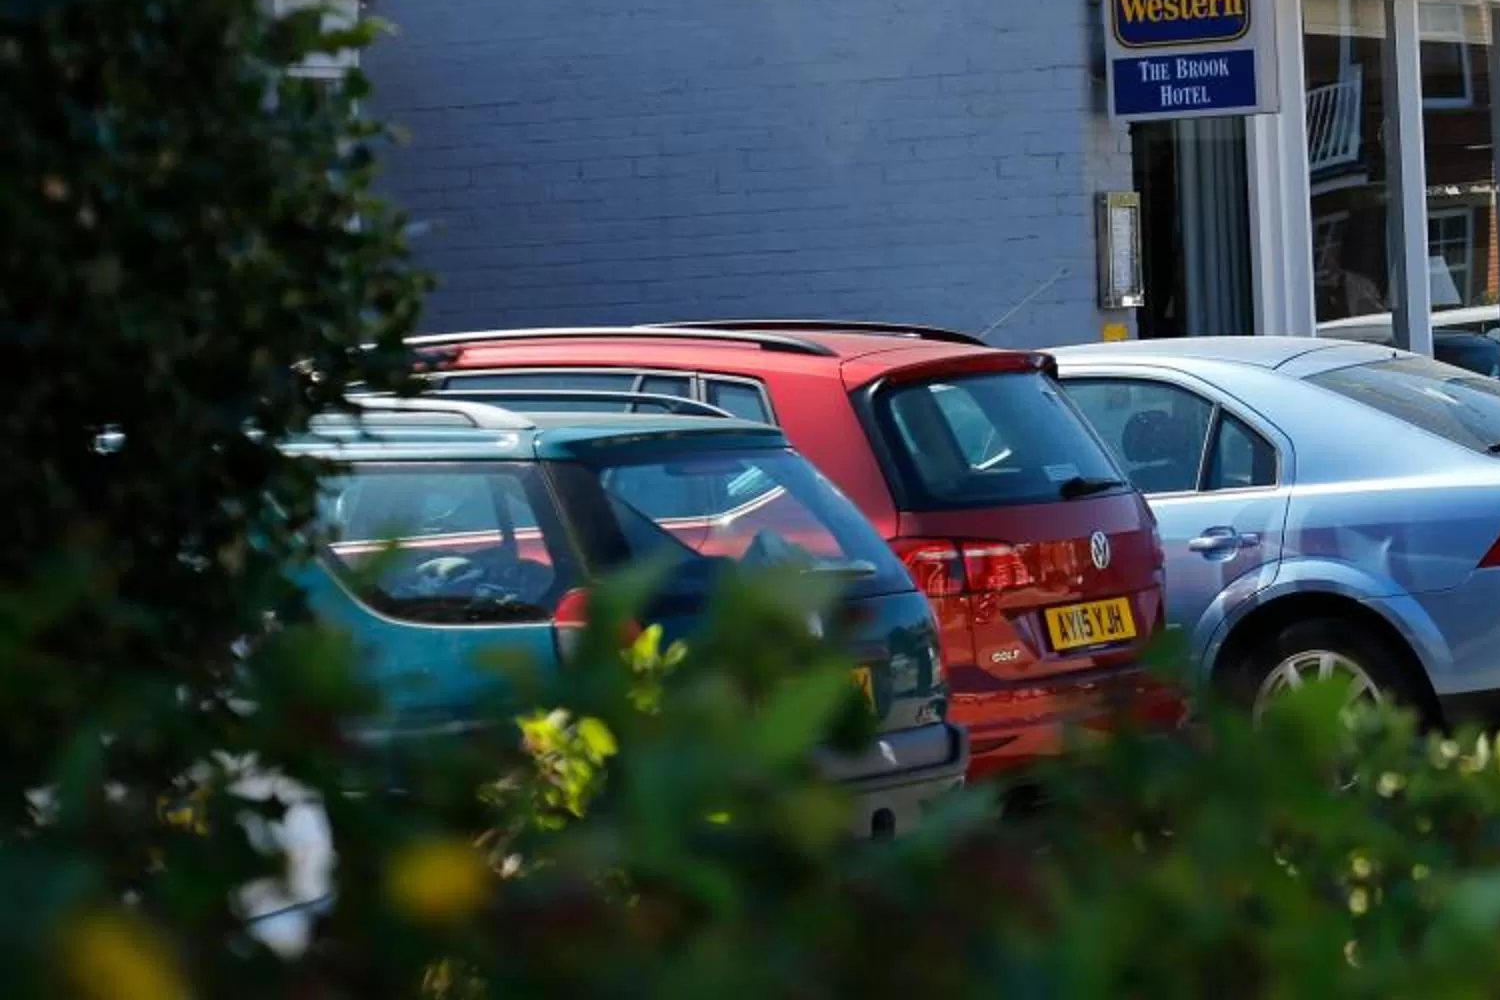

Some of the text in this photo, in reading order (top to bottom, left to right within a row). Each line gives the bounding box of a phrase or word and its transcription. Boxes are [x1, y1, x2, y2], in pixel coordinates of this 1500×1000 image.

[1138, 56, 1229, 82] THE BROOK
[1160, 85, 1211, 107] HOTEL
